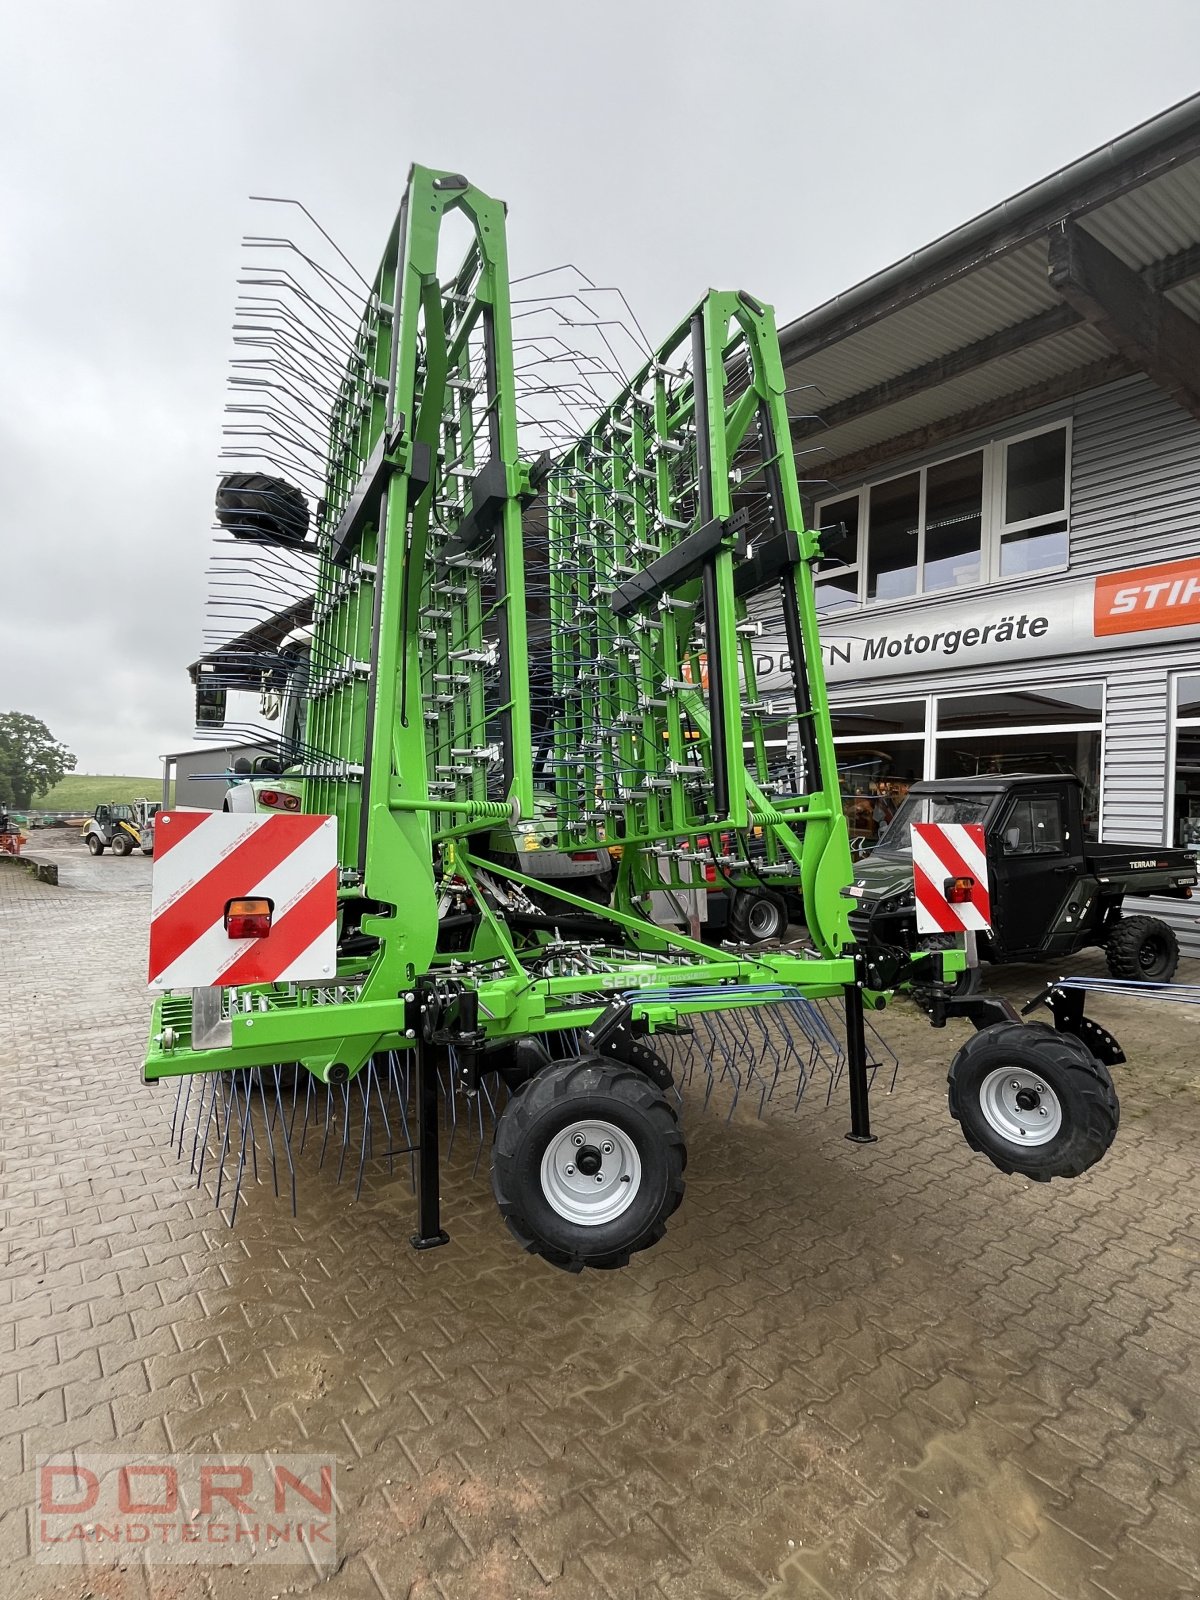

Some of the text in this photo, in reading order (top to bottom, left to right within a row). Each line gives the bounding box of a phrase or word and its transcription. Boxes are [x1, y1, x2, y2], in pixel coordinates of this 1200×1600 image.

[756, 642, 851, 676] DON
[862, 614, 1049, 662] Motorgeräte
[1129, 860, 1156, 869] TERRAIN
